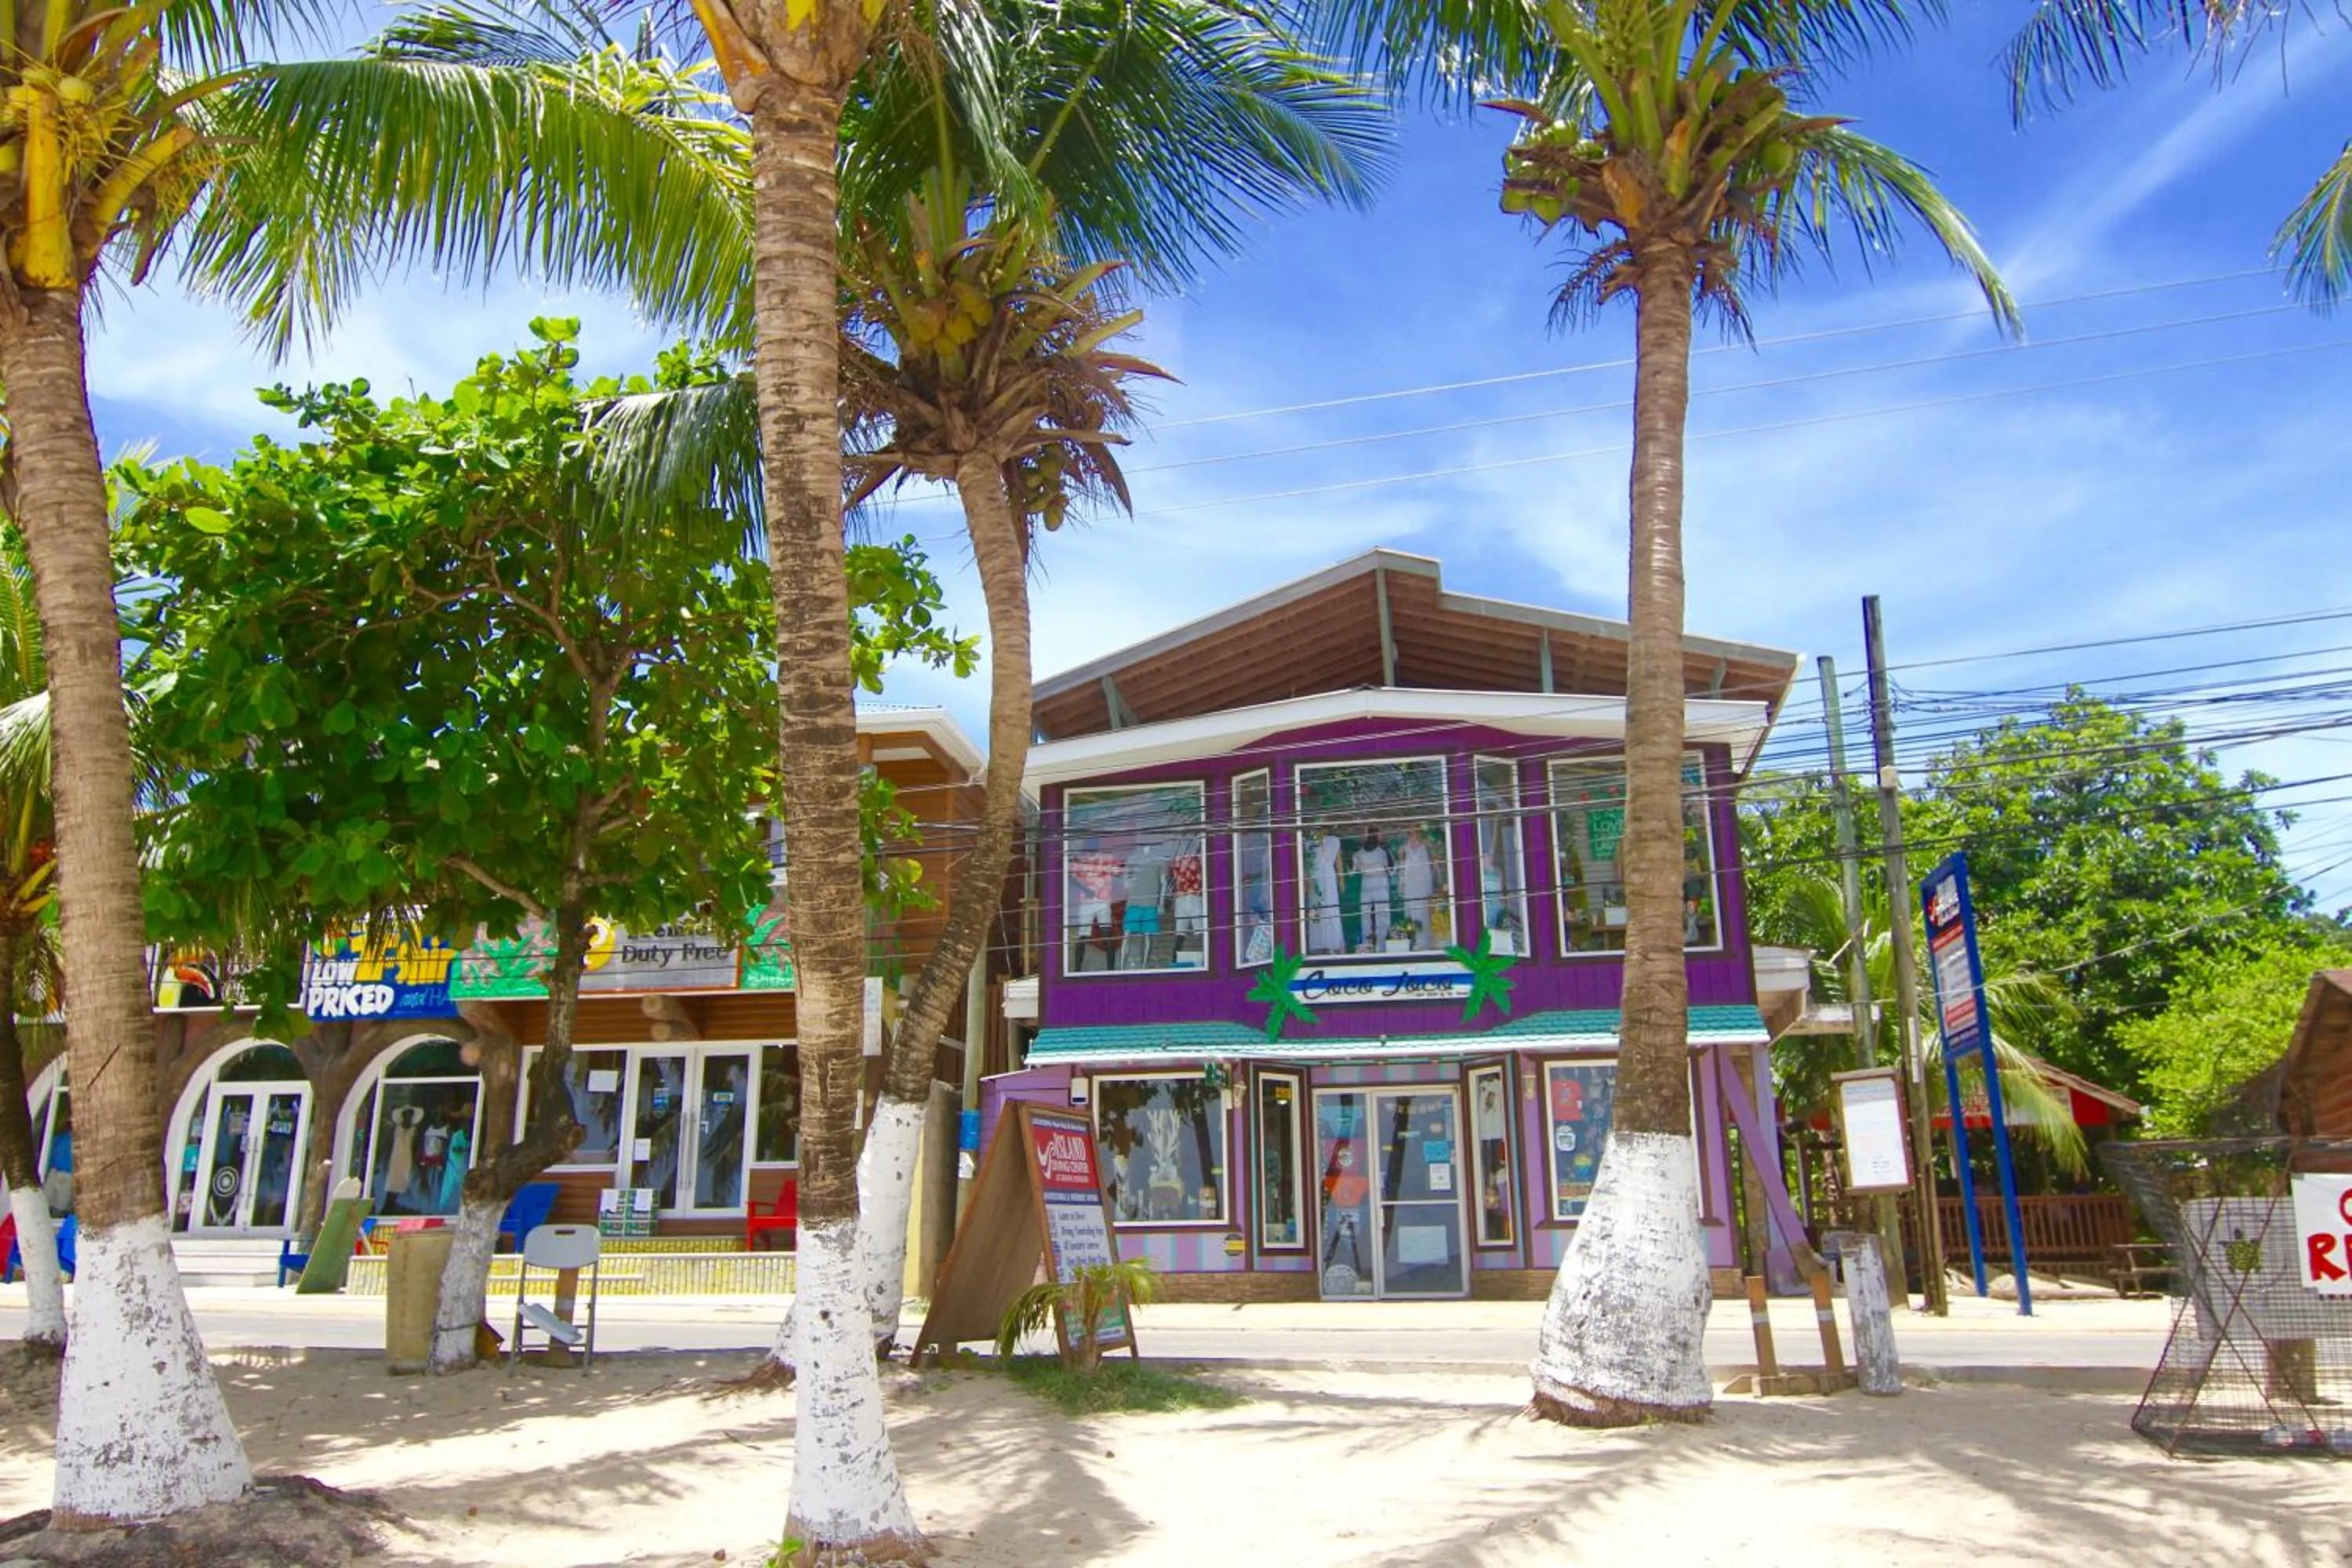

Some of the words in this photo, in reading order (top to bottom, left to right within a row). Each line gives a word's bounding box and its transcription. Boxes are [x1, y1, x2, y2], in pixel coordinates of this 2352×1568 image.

[622, 944, 673, 967] Duty
[682, 942, 728, 961] Free
[311, 958, 358, 986] LOW
[1303, 970, 1373, 1000] Coco
[307, 984, 394, 1018] PRICED
